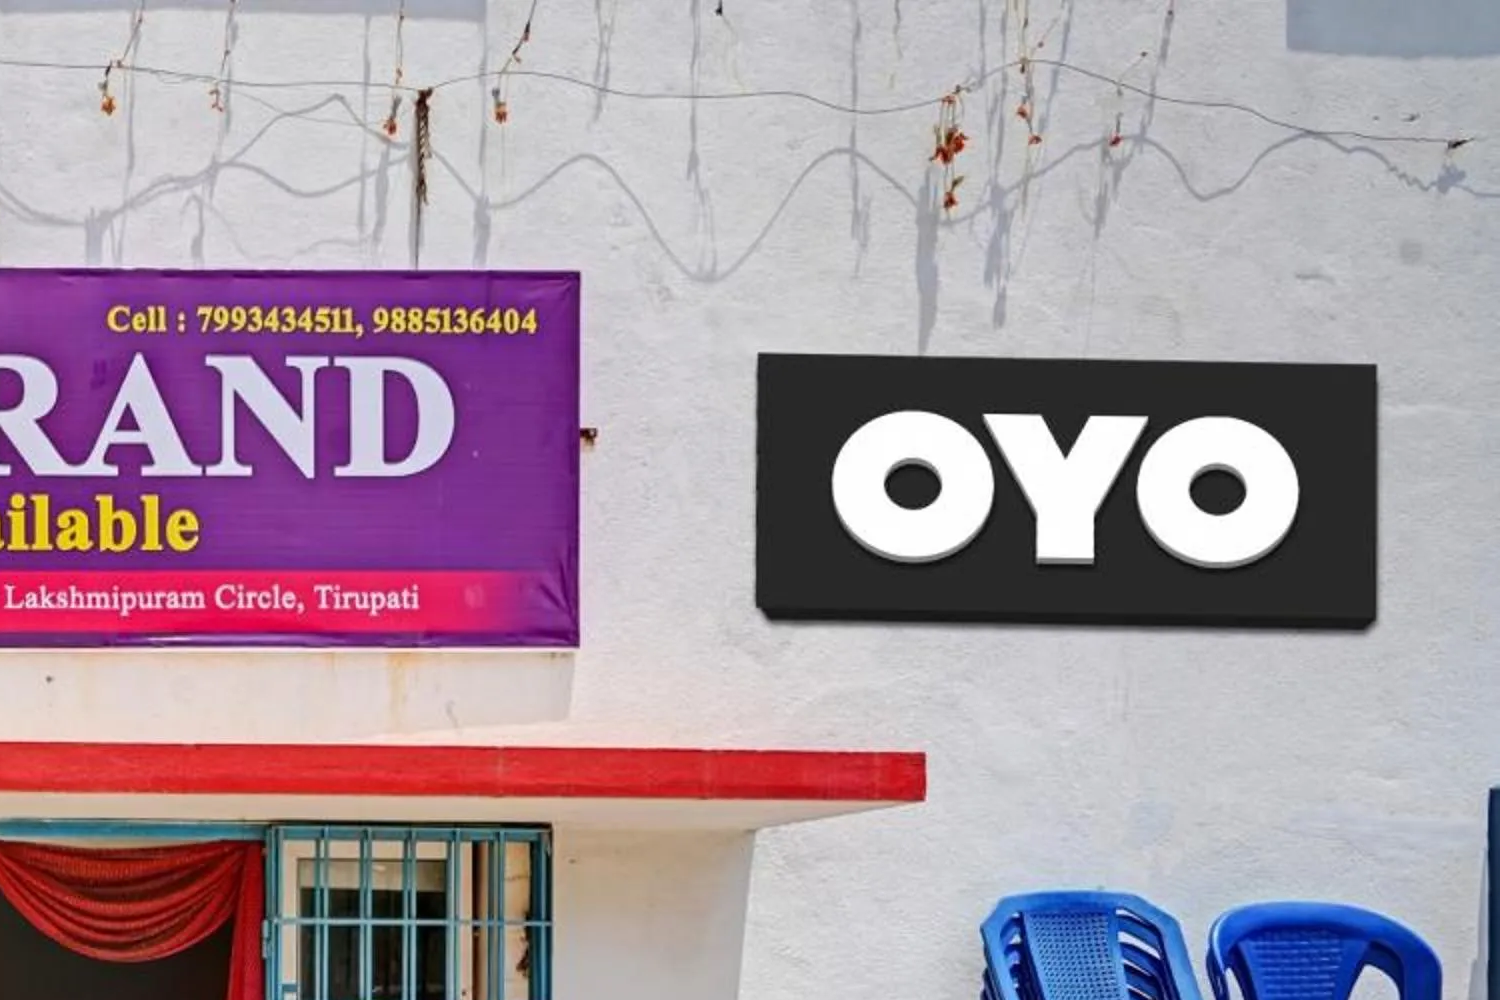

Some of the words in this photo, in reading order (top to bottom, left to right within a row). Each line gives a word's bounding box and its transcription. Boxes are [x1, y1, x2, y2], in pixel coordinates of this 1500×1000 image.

[107, 306, 166, 333] Cell
[197, 306, 365, 337] 7993434511,
[373, 307, 537, 335] 9885136404
[832, 409, 1300, 569] OYO
[3, 584, 206, 619] Lakshmipuram
[214, 584, 305, 615] Circle,
[313, 584, 420, 618] Tirupati
